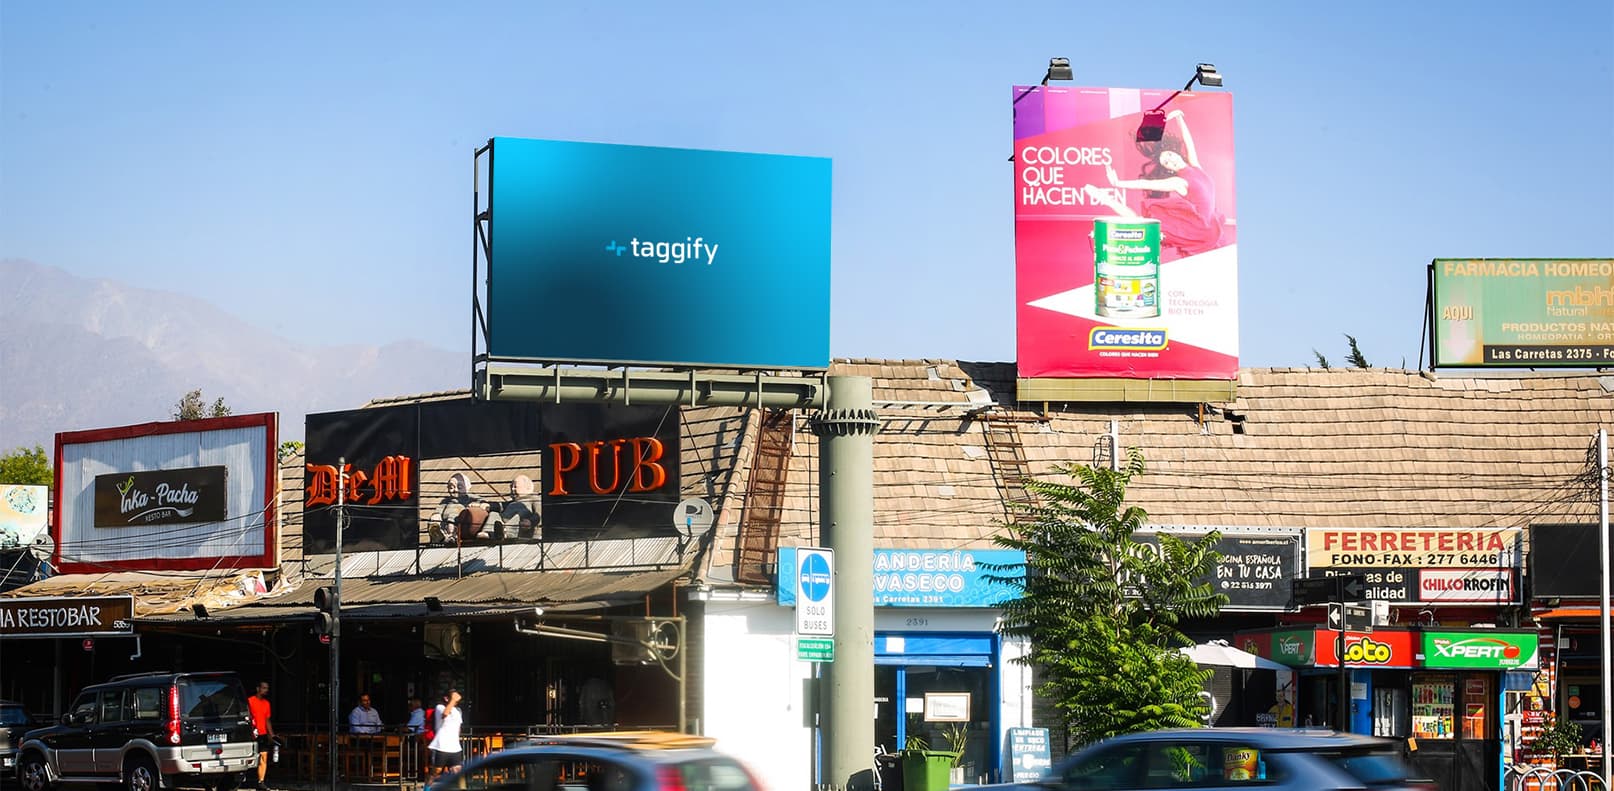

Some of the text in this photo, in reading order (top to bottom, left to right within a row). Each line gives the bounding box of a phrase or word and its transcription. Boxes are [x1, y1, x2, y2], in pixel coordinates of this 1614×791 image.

[1022, 146, 1112, 166] COLORES
[1022, 166, 1064, 187] QUE
[1022, 187, 1085, 205] HACEN
[630, 236, 719, 265] taggify
[1444, 262, 1614, 277] FARMACIA HOMEO
[1546, 306, 1588, 317] Natural
[1502, 322, 1586, 333] PRODUCTOS
[1095, 331, 1162, 345] Ceresita
[1518, 333, 1583, 341] HOMEOPATIA
[1492, 349, 1511, 359] Las
[1514, 348, 1562, 359] Carretas
[1566, 349, 1592, 359] 2375
[548, 436, 666, 496] PUB
[1323, 532, 1505, 551] FERRETERIA
[874, 550, 977, 572] ANDERÍA
[1245, 554, 1282, 565] ESPAÑOLA
[1331, 554, 1413, 565] FONO-FAX
[1427, 554, 1455, 565] 277
[1460, 554, 1498, 565] 6446
[1217, 564, 1282, 579] EN TU CASA
[1386, 571, 1404, 583] de
[873, 573, 965, 592] VASECO
[1423, 578, 1510, 591] CHILCORROFIN
[1365, 587, 1406, 599] alidad
[17, 605, 102, 628] RESTOBAR
[806, 606, 826, 616] SOLO
[803, 620, 828, 630] BUSES
